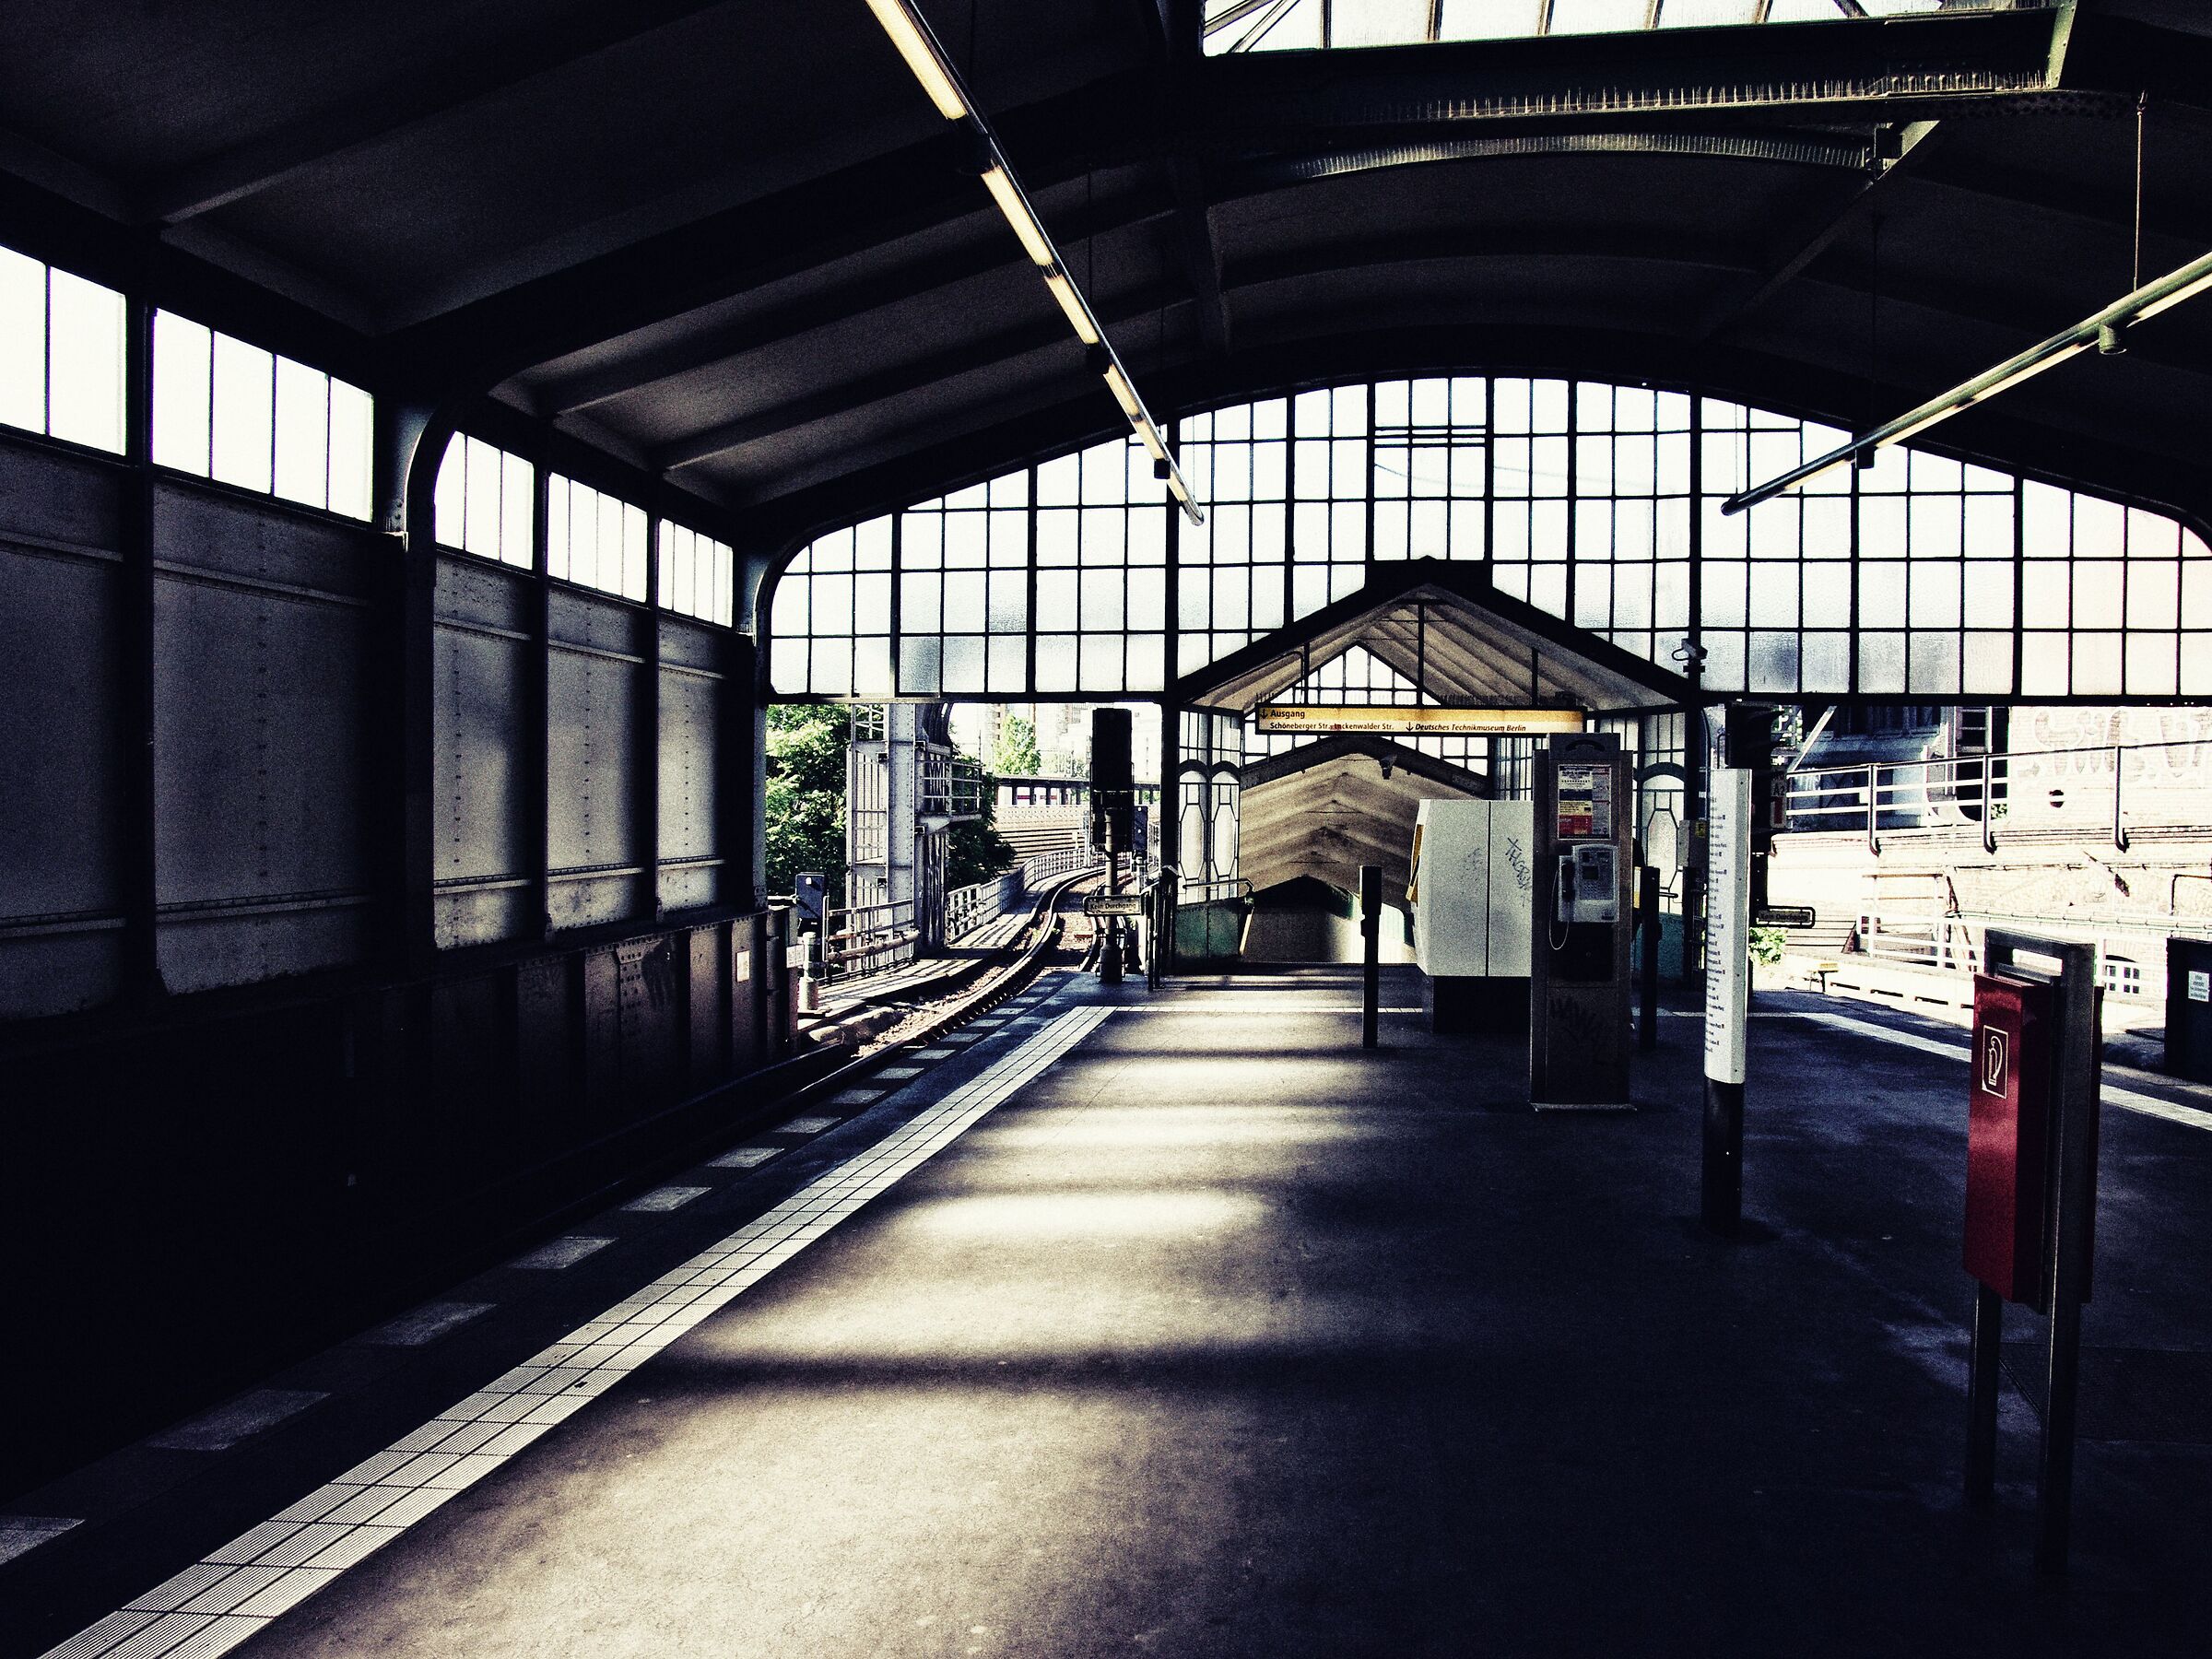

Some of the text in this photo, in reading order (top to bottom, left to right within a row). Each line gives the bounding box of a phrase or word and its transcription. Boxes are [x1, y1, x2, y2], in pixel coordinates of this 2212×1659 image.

[1270, 709, 1306, 719] Ausgang
[1270, 722, 1317, 731] Schöneberger
[1452, 724, 1505, 732] Technikmuseum
